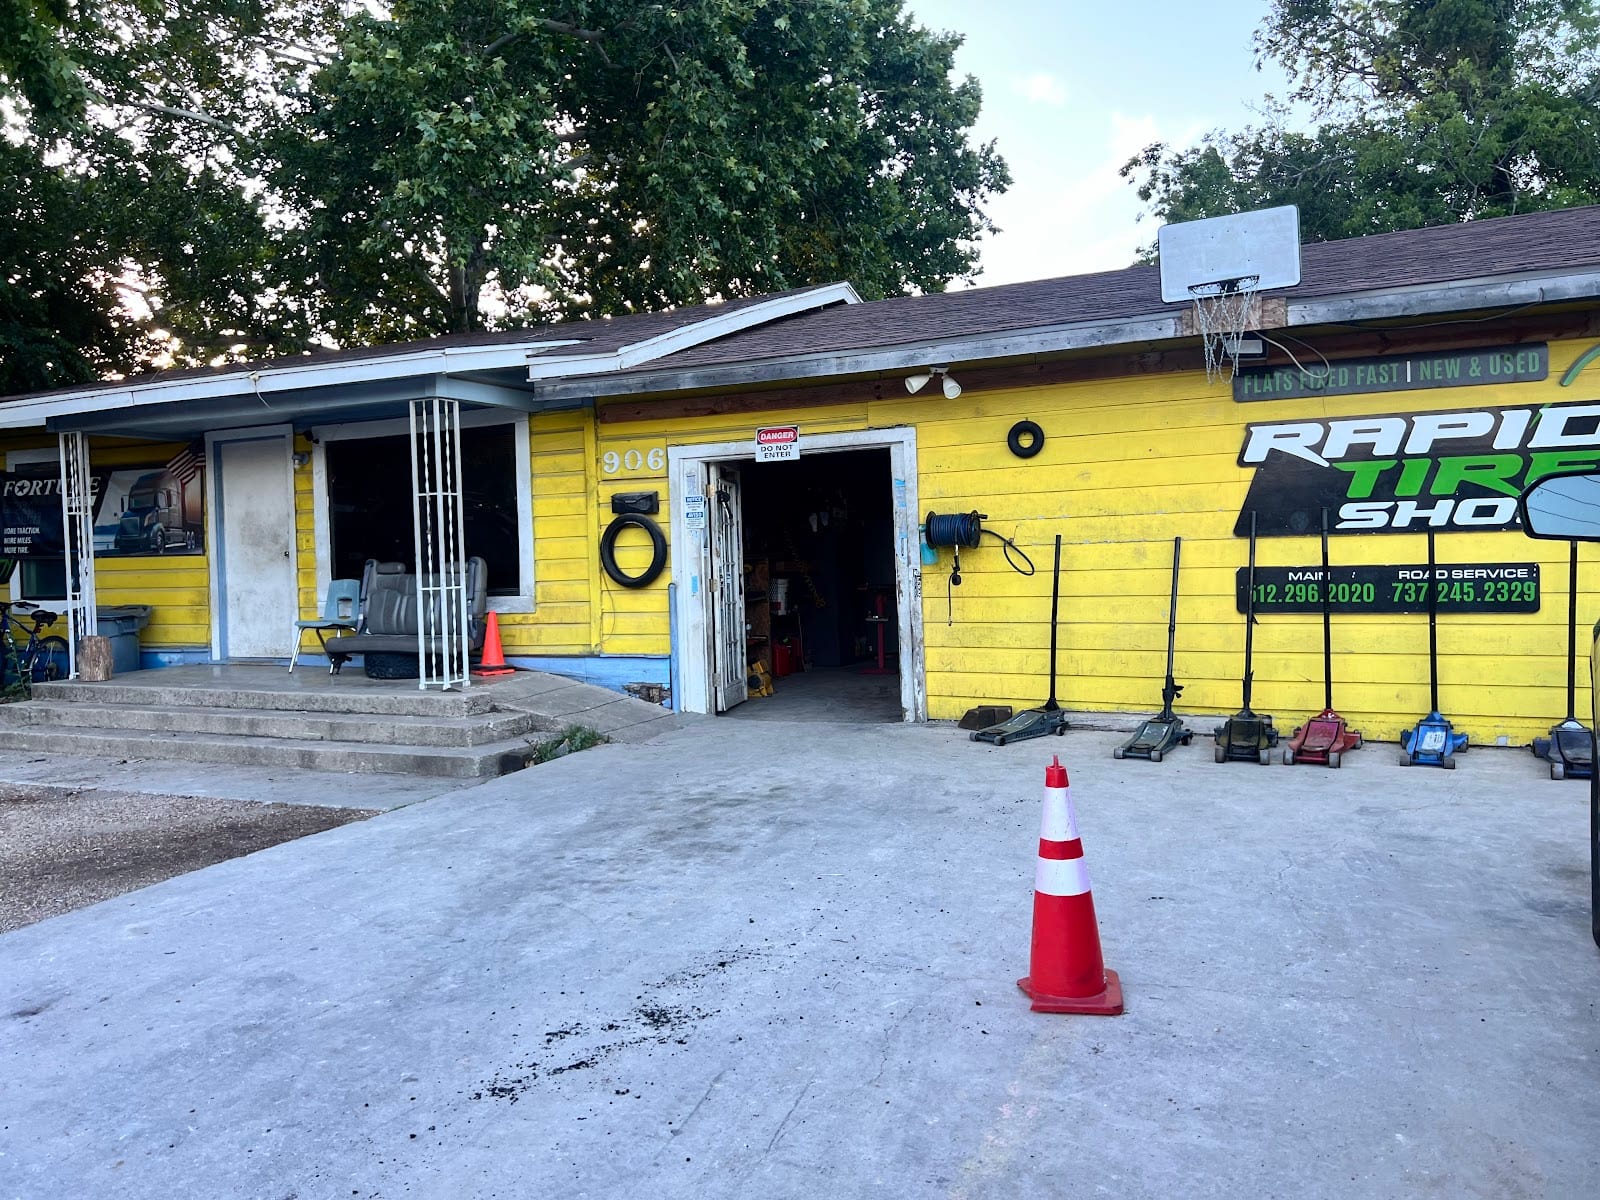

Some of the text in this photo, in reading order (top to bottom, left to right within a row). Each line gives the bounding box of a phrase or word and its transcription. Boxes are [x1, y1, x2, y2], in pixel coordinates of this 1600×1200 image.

[1243, 352, 1540, 394] FLATS FIXED FAST NEW & USED
[760, 431, 794, 441] DANGER
[1243, 404, 1600, 468] RAPID
[603, 447, 665, 474] 906
[764, 451, 791, 459] ENTER
[3, 477, 101, 497] FORTUE
[1335, 495, 1521, 529] SHO
[1288, 571, 1331, 581] MAIN
[1451, 568, 1529, 579] SERVICE
[1391, 581, 1537, 603] 737245.2329
